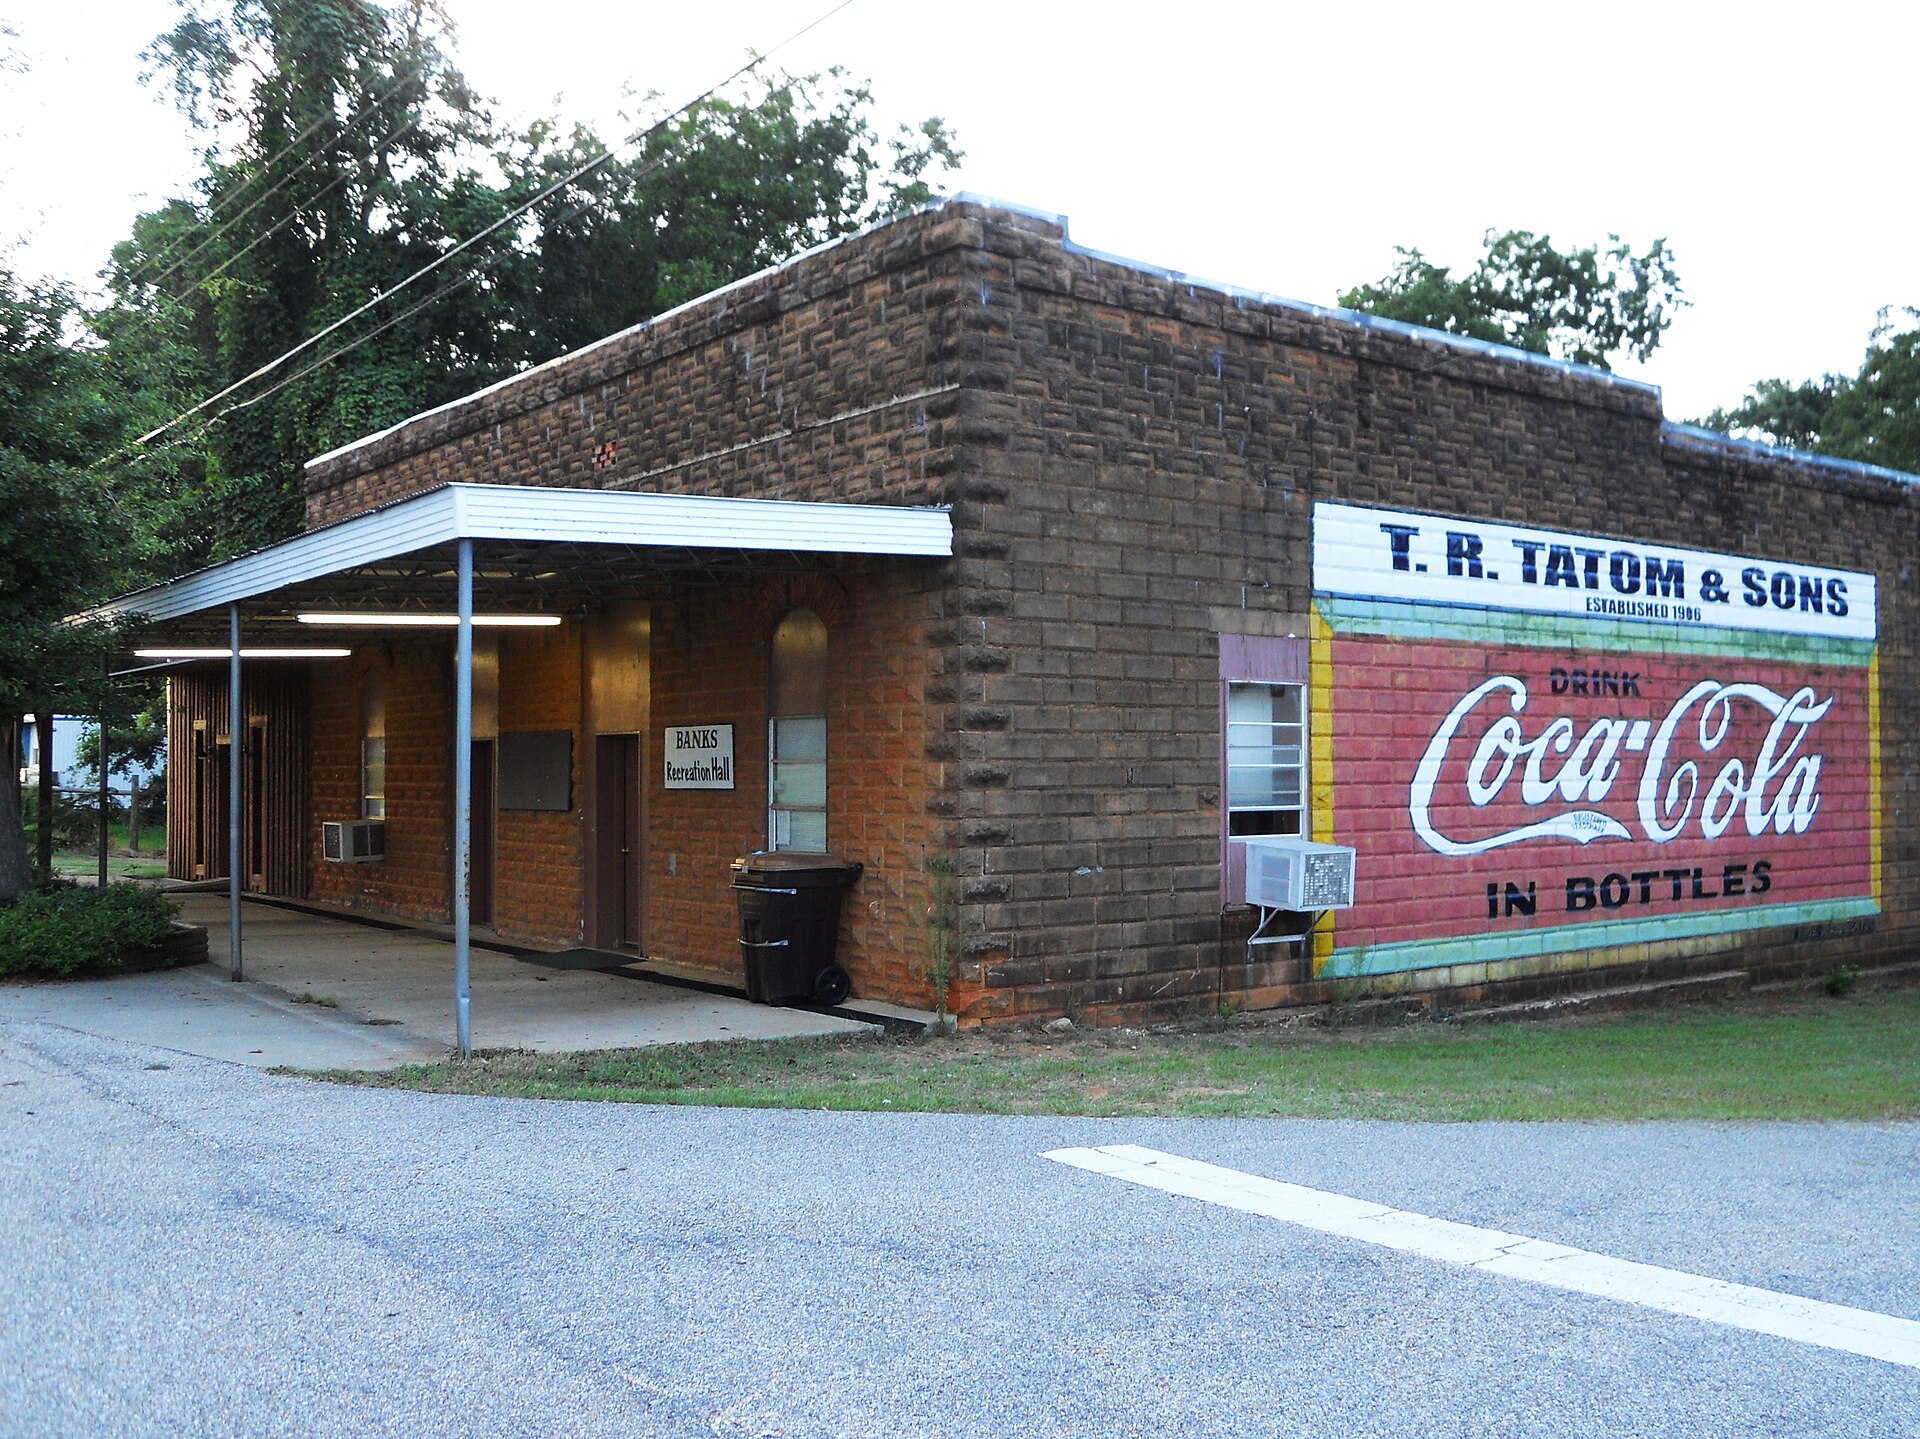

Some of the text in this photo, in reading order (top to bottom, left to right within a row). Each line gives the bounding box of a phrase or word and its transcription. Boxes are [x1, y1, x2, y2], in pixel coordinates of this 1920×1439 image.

[1380, 523, 1849, 617] T. R. TATOM & SONS
[1586, 597, 1669, 618] ESTABLISHED
[1550, 667, 1641, 697] DRINK
[676, 729, 718, 749] BANKS
[666, 756, 730, 781] Recreation Hall
[1409, 675, 1834, 857] Coca-Cola
[1487, 861, 1772, 919] IN BOTTLES
